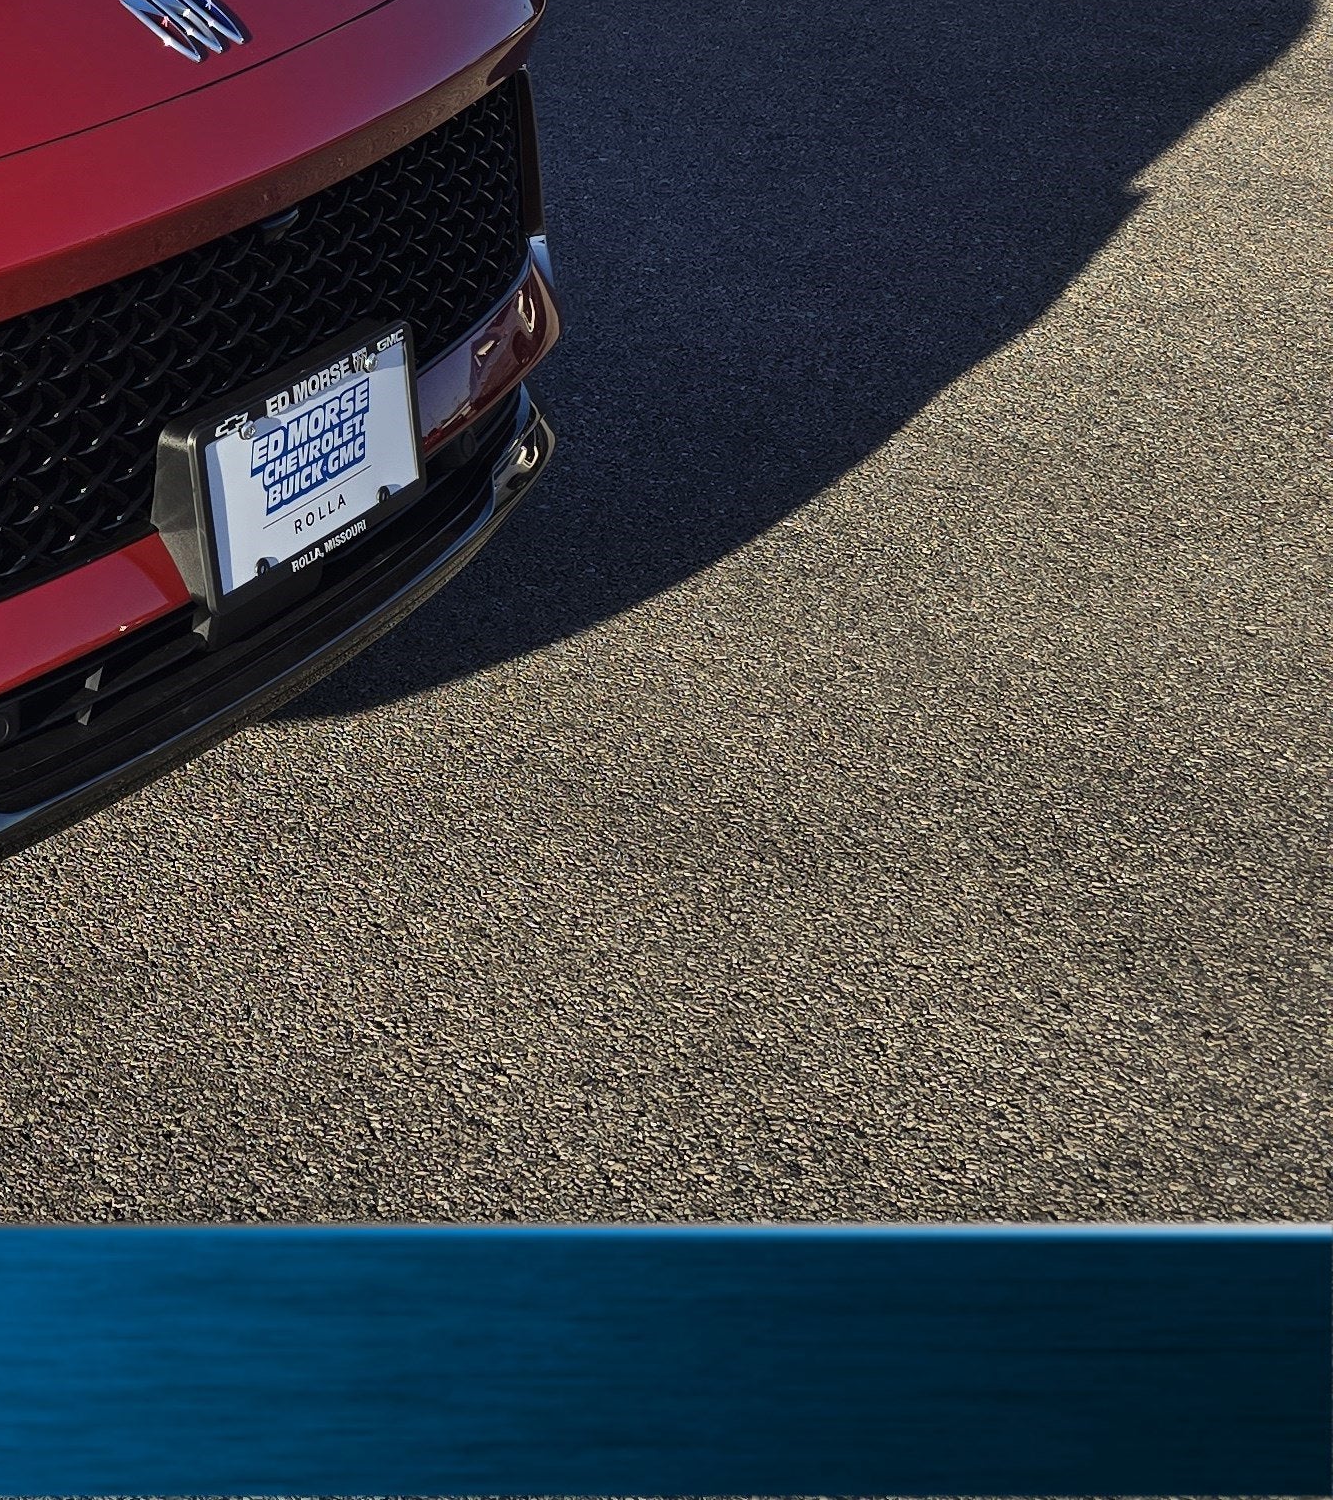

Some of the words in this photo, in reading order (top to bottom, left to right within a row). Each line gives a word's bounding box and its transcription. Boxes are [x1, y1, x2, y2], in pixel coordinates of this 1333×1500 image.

[377, 329, 404, 353] GMC
[266, 391, 290, 418] ED
[292, 357, 349, 405] MORSE
[252, 429, 285, 471] ED
[288, 385, 369, 453] MORSE
[294, 494, 347, 534] ROLLA
[291, 547, 325, 573] ROLLA,
[323, 519, 367, 554] MISSOURI
